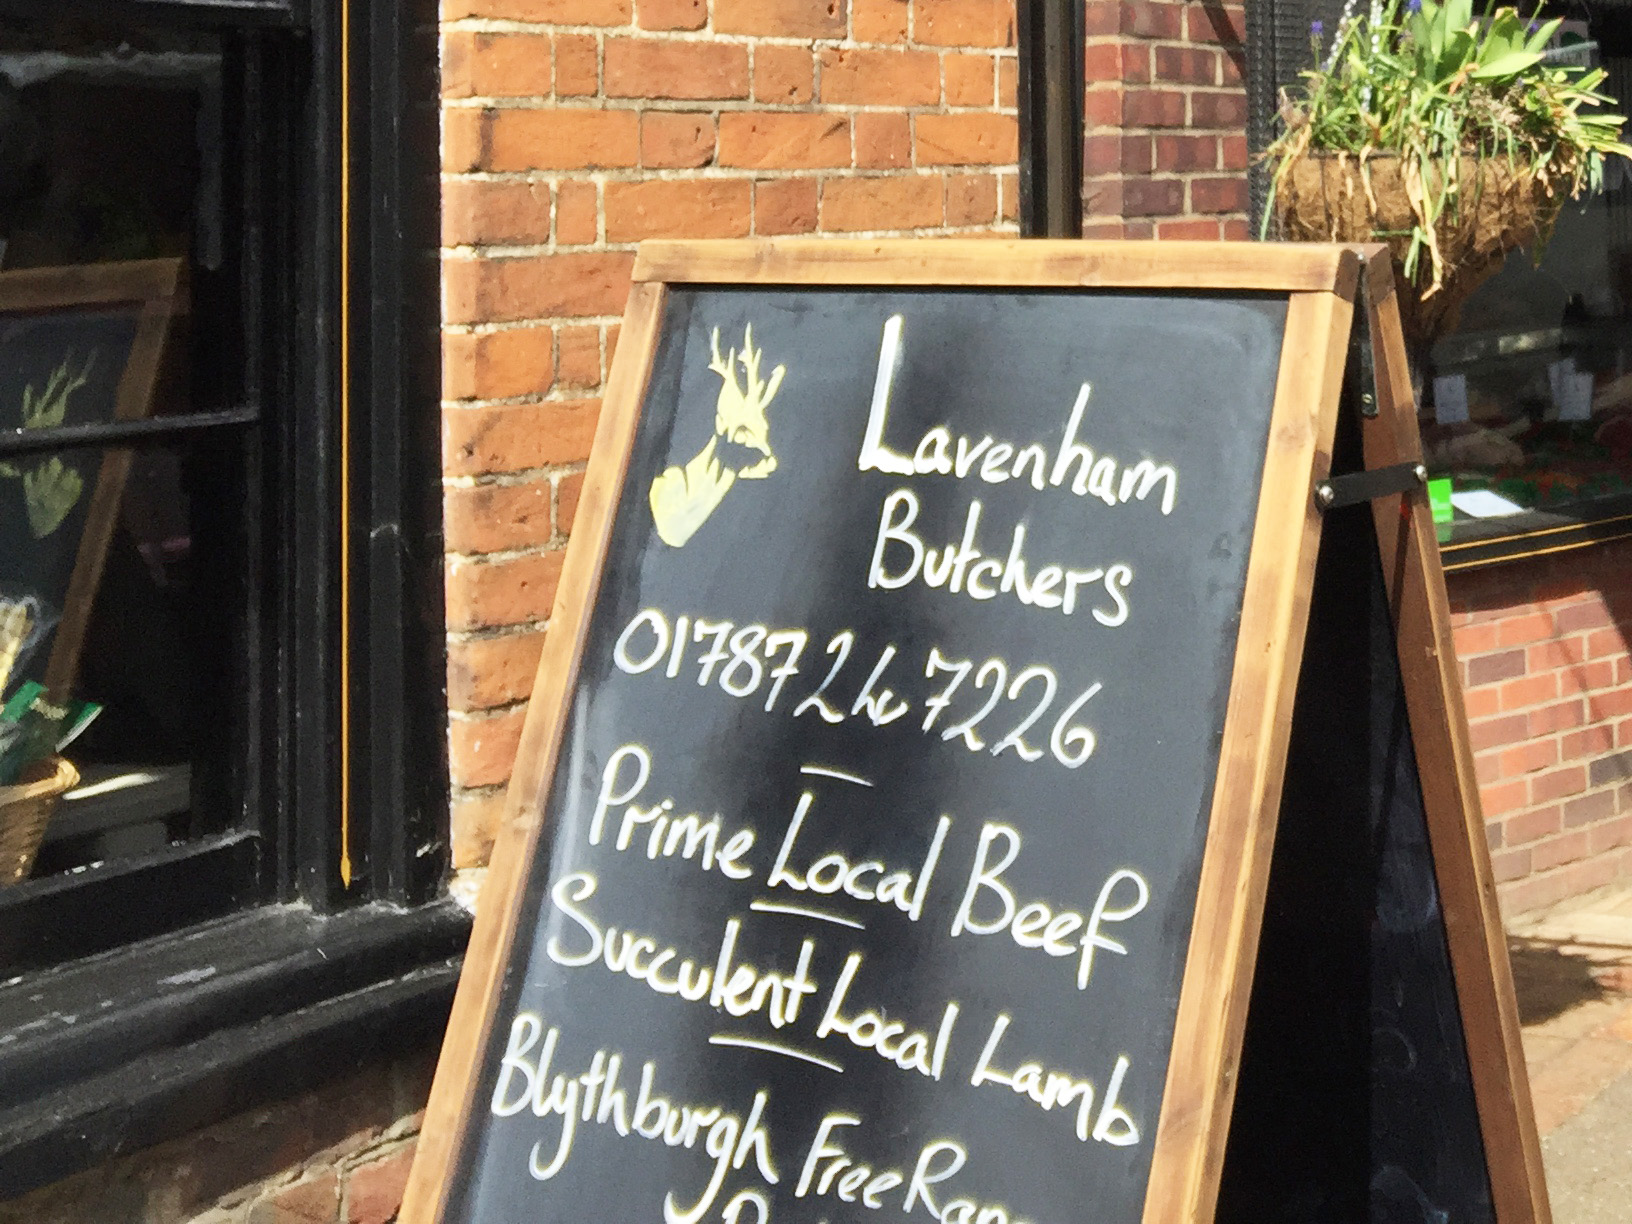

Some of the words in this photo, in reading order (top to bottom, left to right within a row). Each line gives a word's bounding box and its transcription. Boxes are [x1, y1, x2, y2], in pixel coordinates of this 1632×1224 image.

[858, 312, 1179, 516] Lavenham
[867, 488, 1134, 628] Butchers
[589, 743, 757, 880] Prime
[766, 791, 952, 922] Local
[950, 822, 1151, 991] Beef
[546, 873, 817, 1029] Succulent
[816, 953, 961, 1081] Local
[970, 1014, 1143, 1147] Lamb
[491, 1012, 779, 1224] Blythburgh
[794, 1114, 903, 1210] Free
